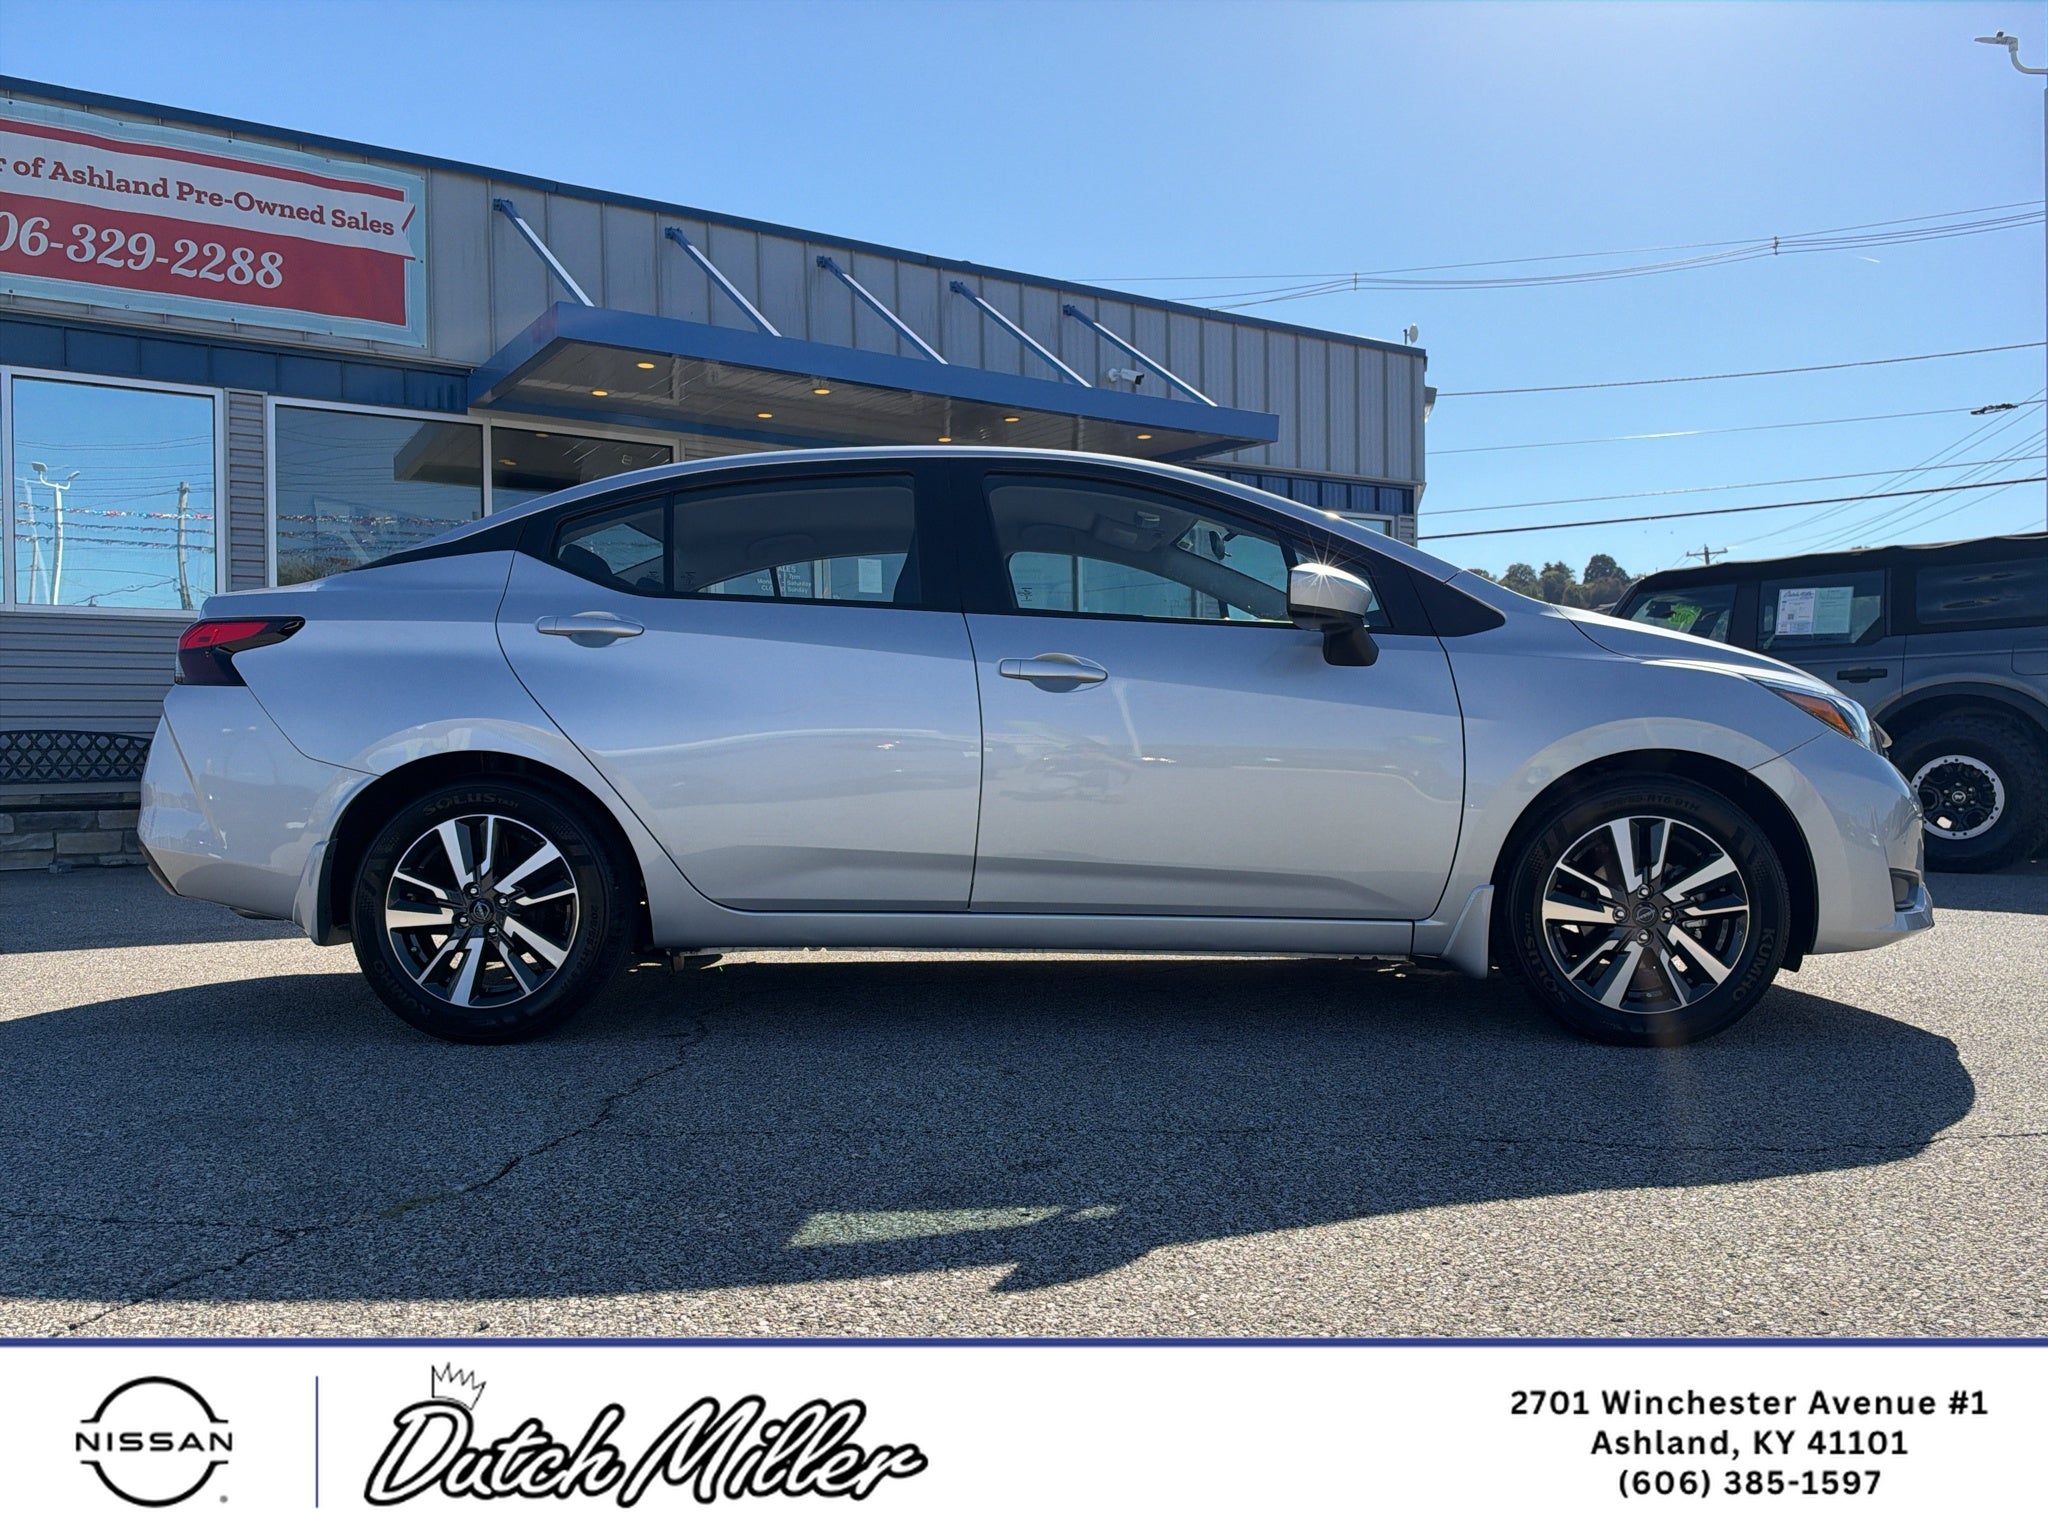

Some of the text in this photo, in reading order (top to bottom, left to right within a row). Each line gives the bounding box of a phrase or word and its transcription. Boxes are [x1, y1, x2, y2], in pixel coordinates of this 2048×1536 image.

[13, 157, 46, 178] of
[48, 161, 170, 199] Ashland
[175, 181, 326, 225] Pre-Owned
[331, 209, 395, 236] Sales
[1733, 927, 1777, 1001] KUMHO
